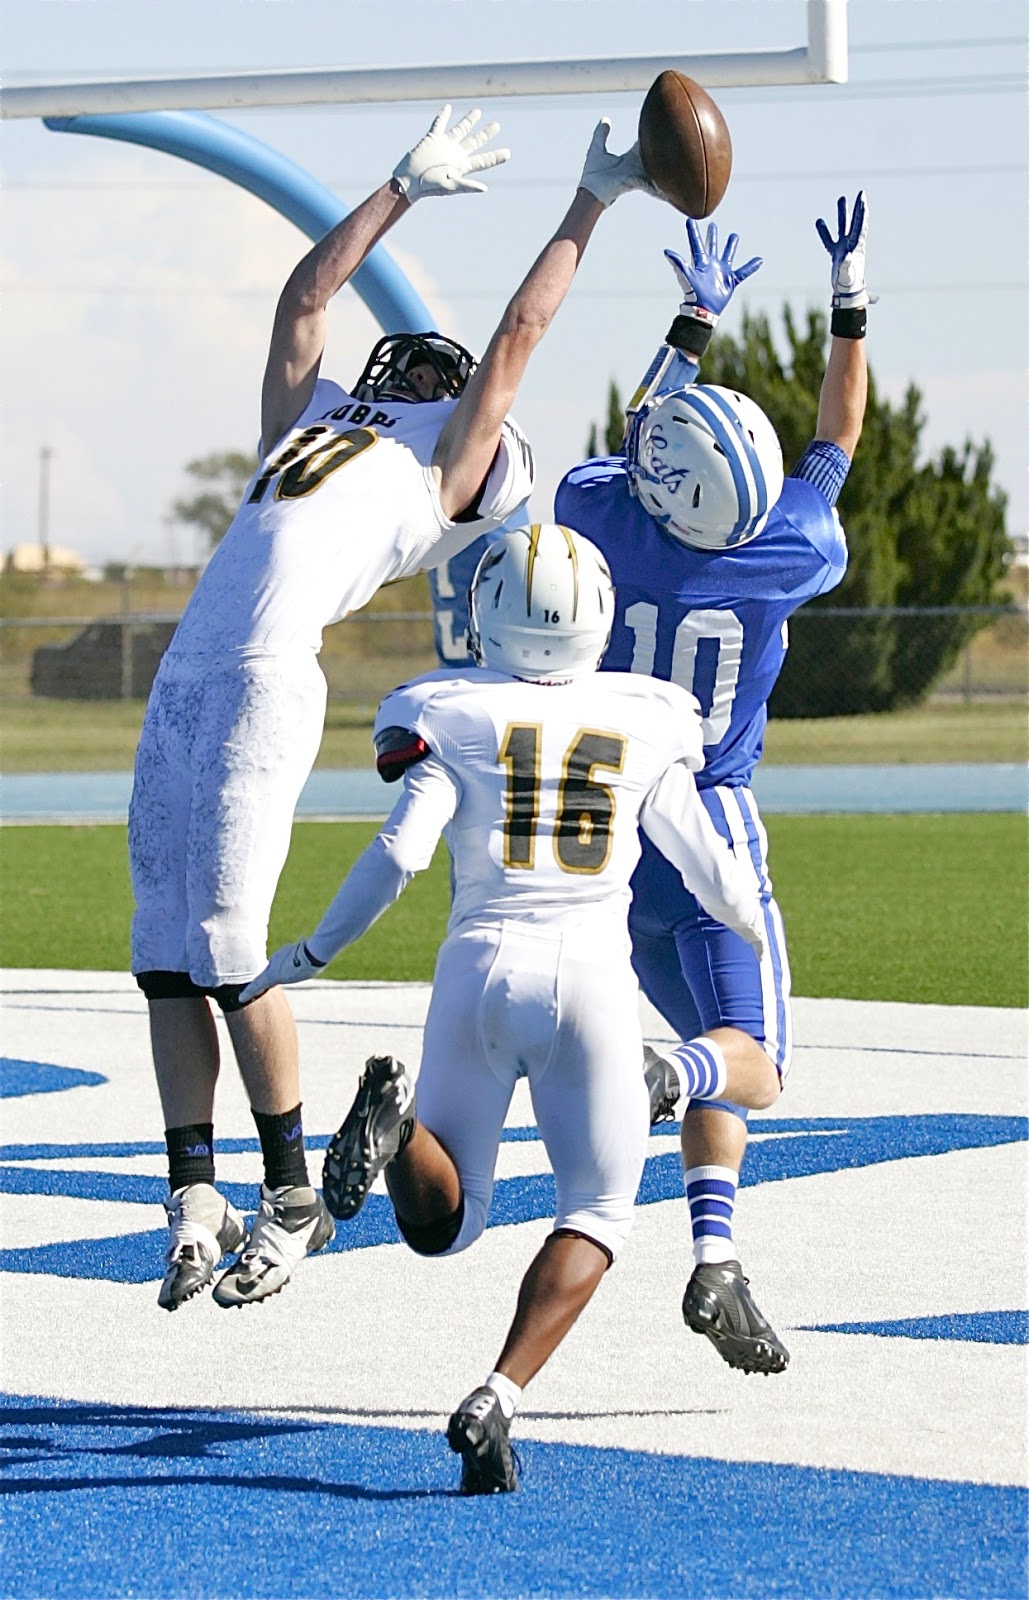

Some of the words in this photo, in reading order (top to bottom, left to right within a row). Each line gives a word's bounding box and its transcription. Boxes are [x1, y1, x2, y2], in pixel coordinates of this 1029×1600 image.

[247, 424, 379, 503] 10
[646, 424, 690, 494] Cats
[544, 610, 560, 623] 16
[625, 601, 743, 746] 10
[497, 721, 628, 875] 16
